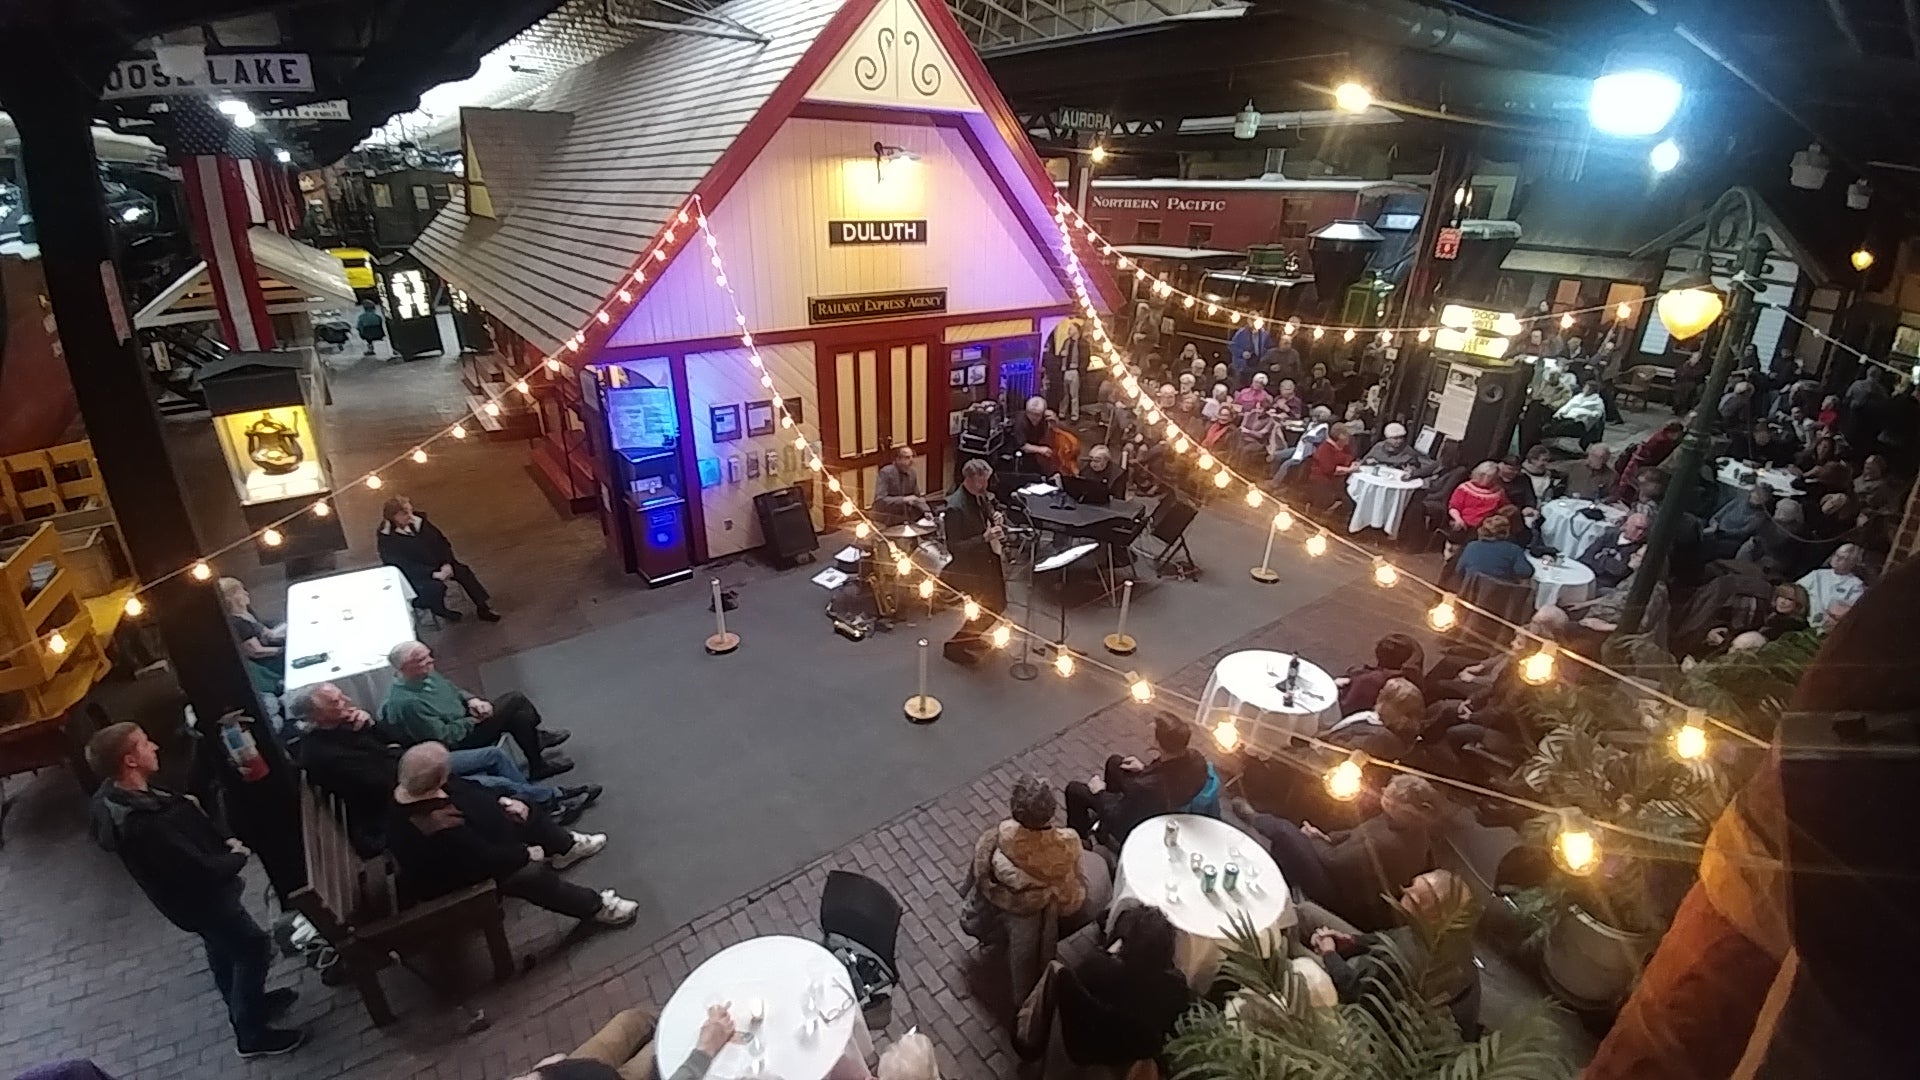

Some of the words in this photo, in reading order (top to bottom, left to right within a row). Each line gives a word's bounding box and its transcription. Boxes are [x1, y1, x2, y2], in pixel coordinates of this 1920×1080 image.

[106, 63, 195, 91] OOS
[207, 58, 301, 85] LAKE
[1061, 110, 1111, 130] AURORA
[1093, 195, 1160, 209] NORTHERN
[1167, 197, 1226, 211] PACIFIC
[842, 222, 917, 241] DULUTH
[818, 302, 862, 316] RAILWAY
[864, 299, 906, 313] EXPRESS
[907, 296, 942, 309] AGENCY
